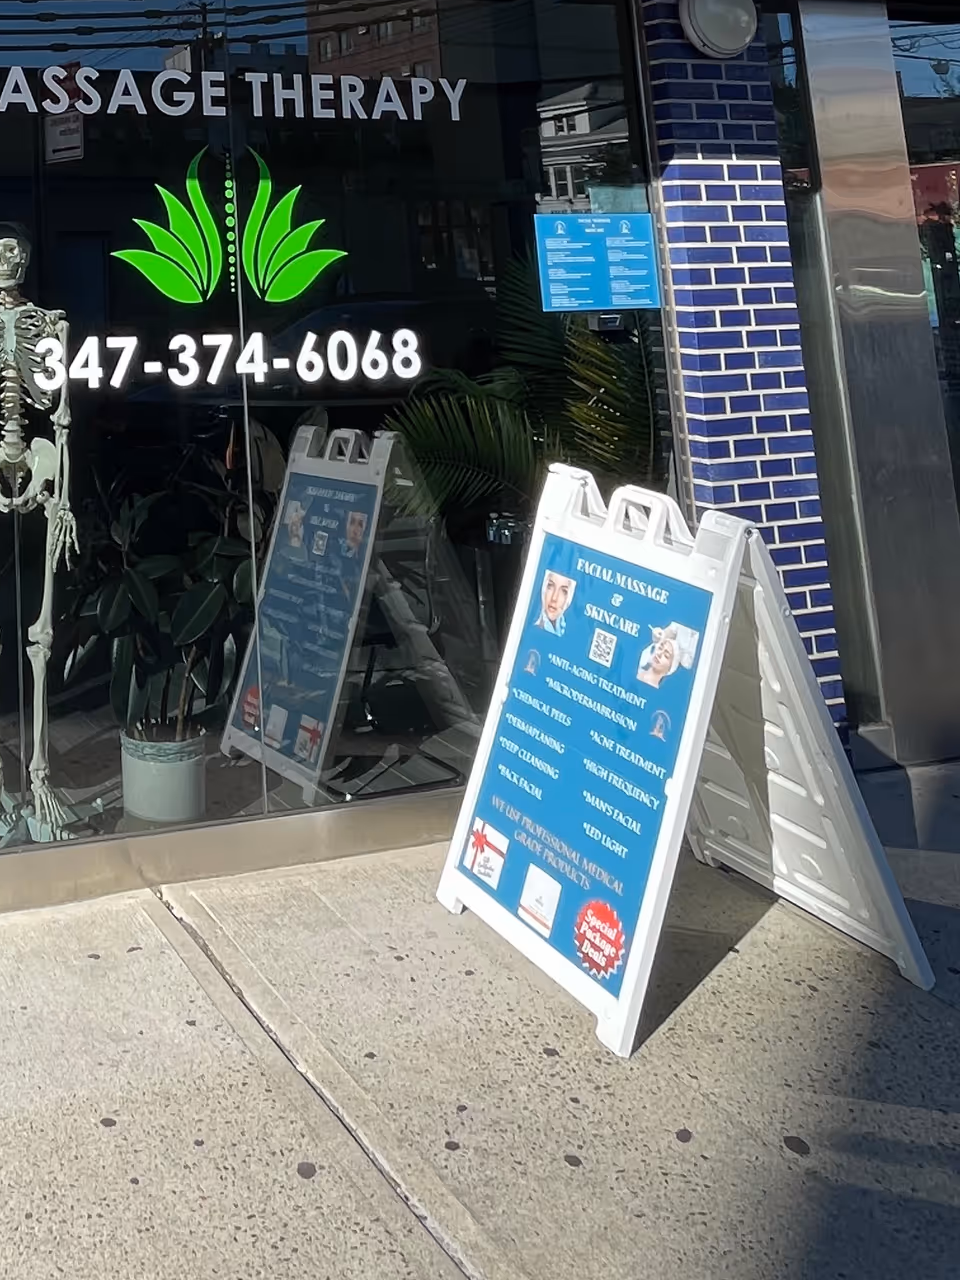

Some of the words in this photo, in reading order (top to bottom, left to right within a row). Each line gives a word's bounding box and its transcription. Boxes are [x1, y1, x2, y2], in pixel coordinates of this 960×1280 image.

[245, 72, 468, 121] THERAPY
[33, 328, 422, 392] 347-374-6068
[577, 558, 614, 583] FACIAL
[615, 573, 669, 604] MASSAGE
[610, 593, 624, 607] &
[583, 602, 641, 638] SKINCARE
[599, 677, 646, 709] TREATMENT
[551, 708, 571, 726] PEELS
[518, 749, 559, 779] CLEANSING
[616, 744, 666, 779] TREATMENT
[519, 778, 542, 800] FACIAL
[608, 773, 659, 809] FREQUENCY
[613, 809, 640, 834] FACIAL
[515, 832, 542, 854] GRADE
[543, 848, 589, 889] PRODUCTS
[521, 816, 580, 865] PROFESSIONAL
[582, 858, 623, 894] MEDICAL
[602, 835, 628, 858] LIGHT
[580, 921, 616, 957] Package
[583, 909, 617, 940] Special
[582, 939, 609, 966] Deals
